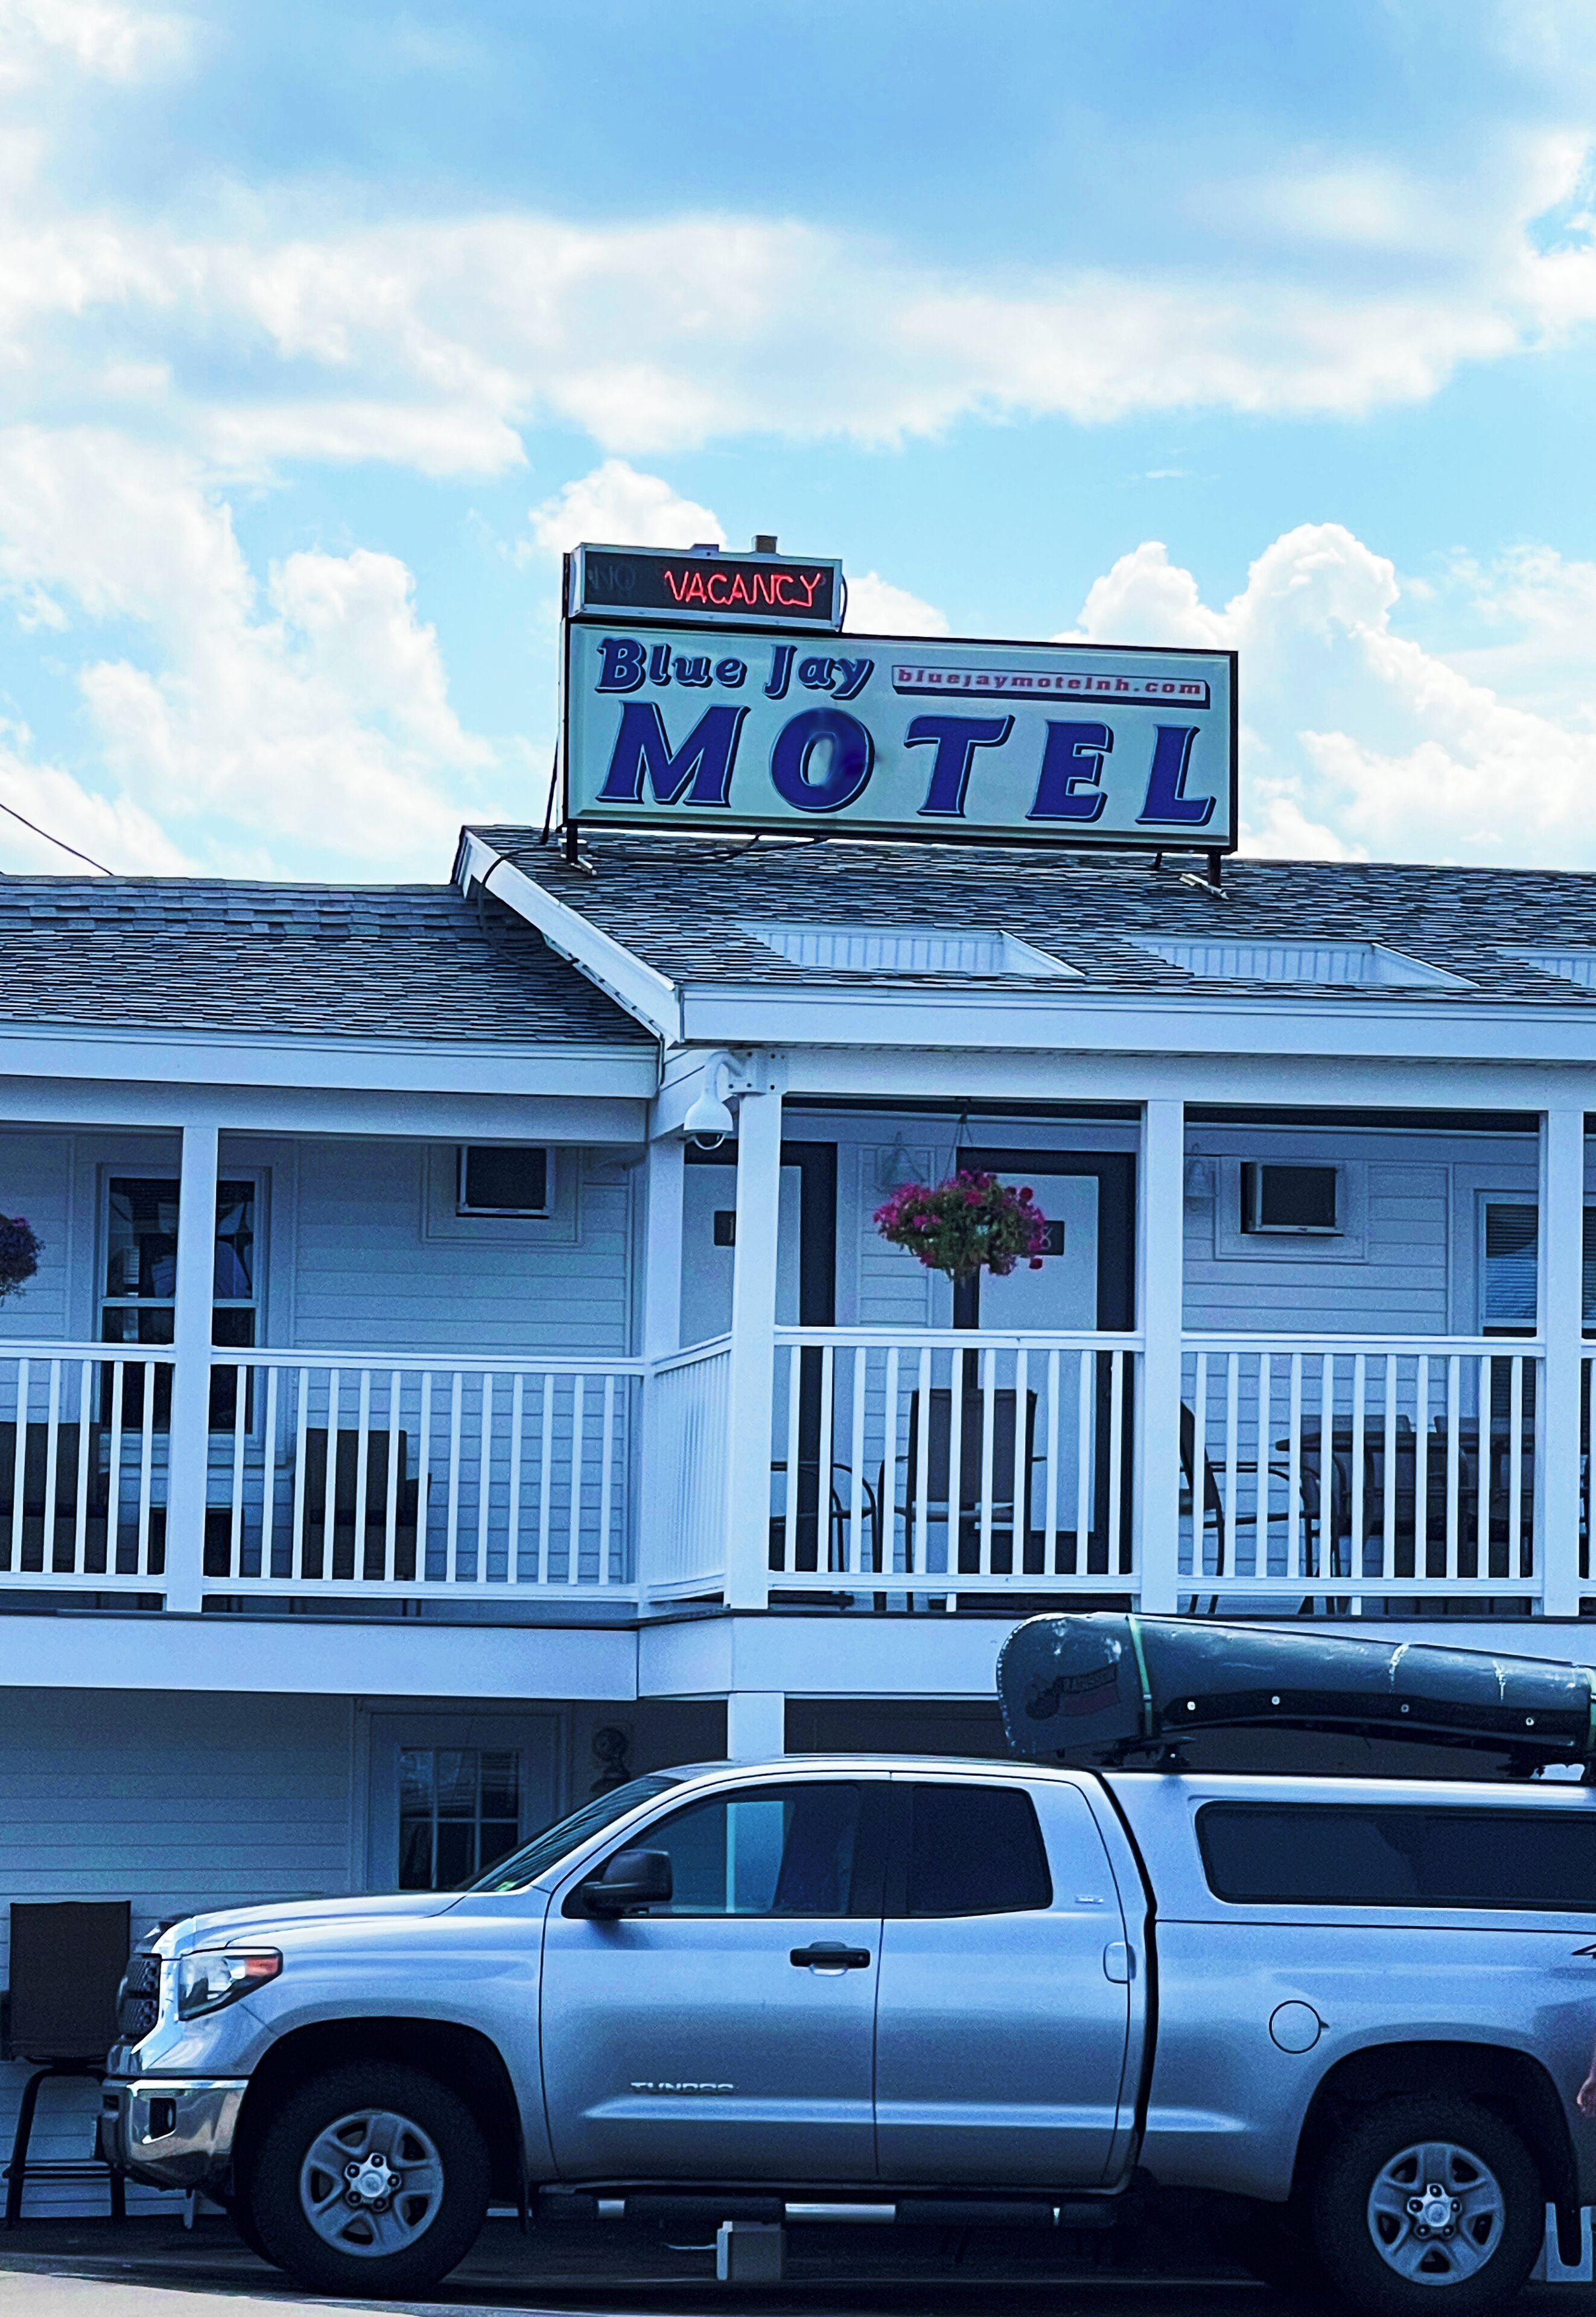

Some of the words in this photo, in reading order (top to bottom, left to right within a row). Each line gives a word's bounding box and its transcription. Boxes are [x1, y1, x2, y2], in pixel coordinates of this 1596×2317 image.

[664, 571, 821, 607] VACANCY
[595, 637, 748, 694] Blue
[762, 644, 874, 700] Jay
[897, 669, 1201, 694] bluejaymotelnh.com
[595, 700, 1216, 825] MOTEL
